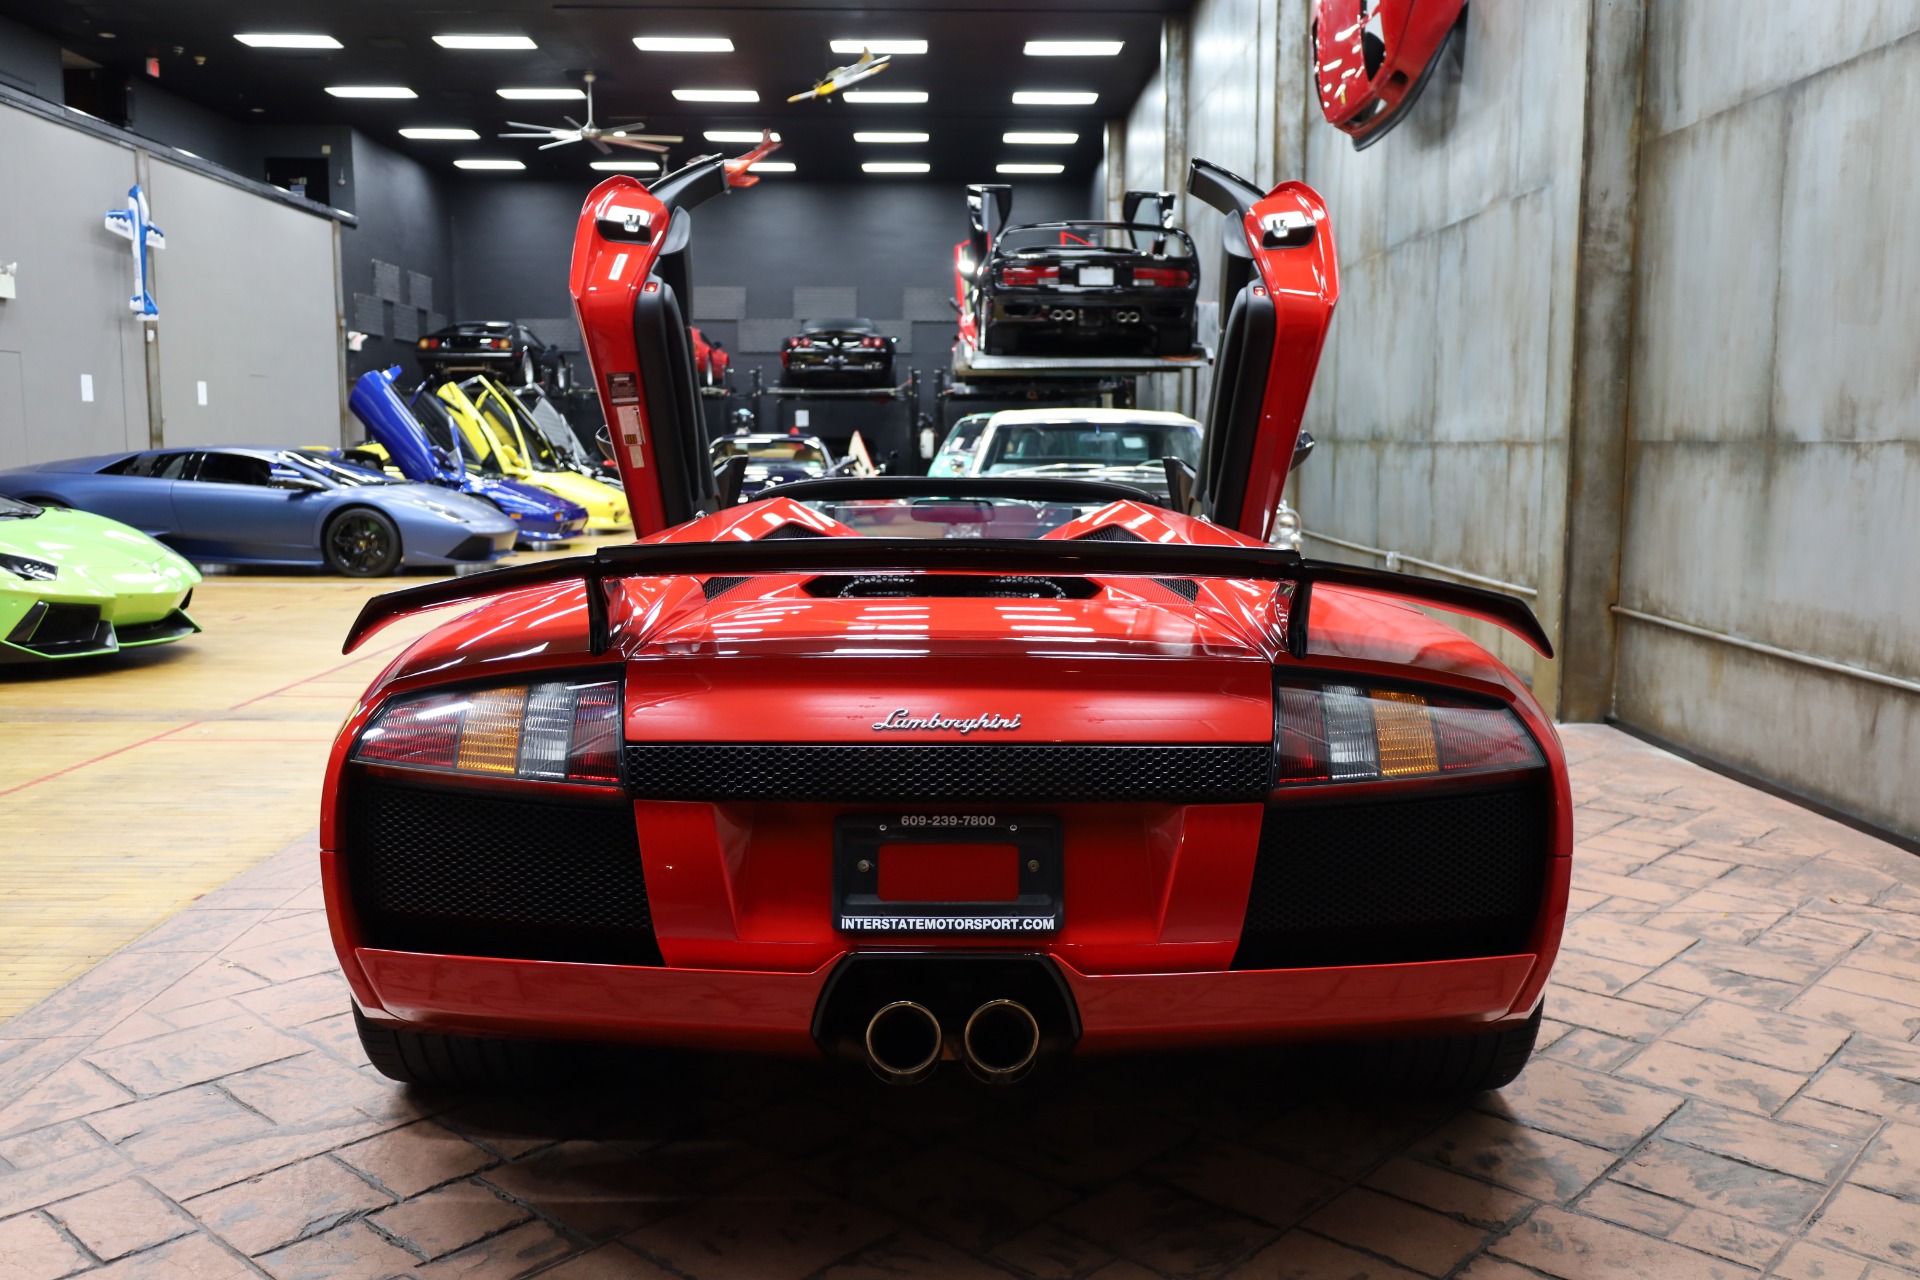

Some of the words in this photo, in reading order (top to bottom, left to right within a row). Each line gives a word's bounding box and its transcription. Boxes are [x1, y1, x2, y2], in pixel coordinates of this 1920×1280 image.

[871, 708, 1022, 734] Lamborghini
[901, 815, 996, 826] 609-239-7800
[841, 918, 1055, 930] INTERSTATEMOTORSPORT.COM
